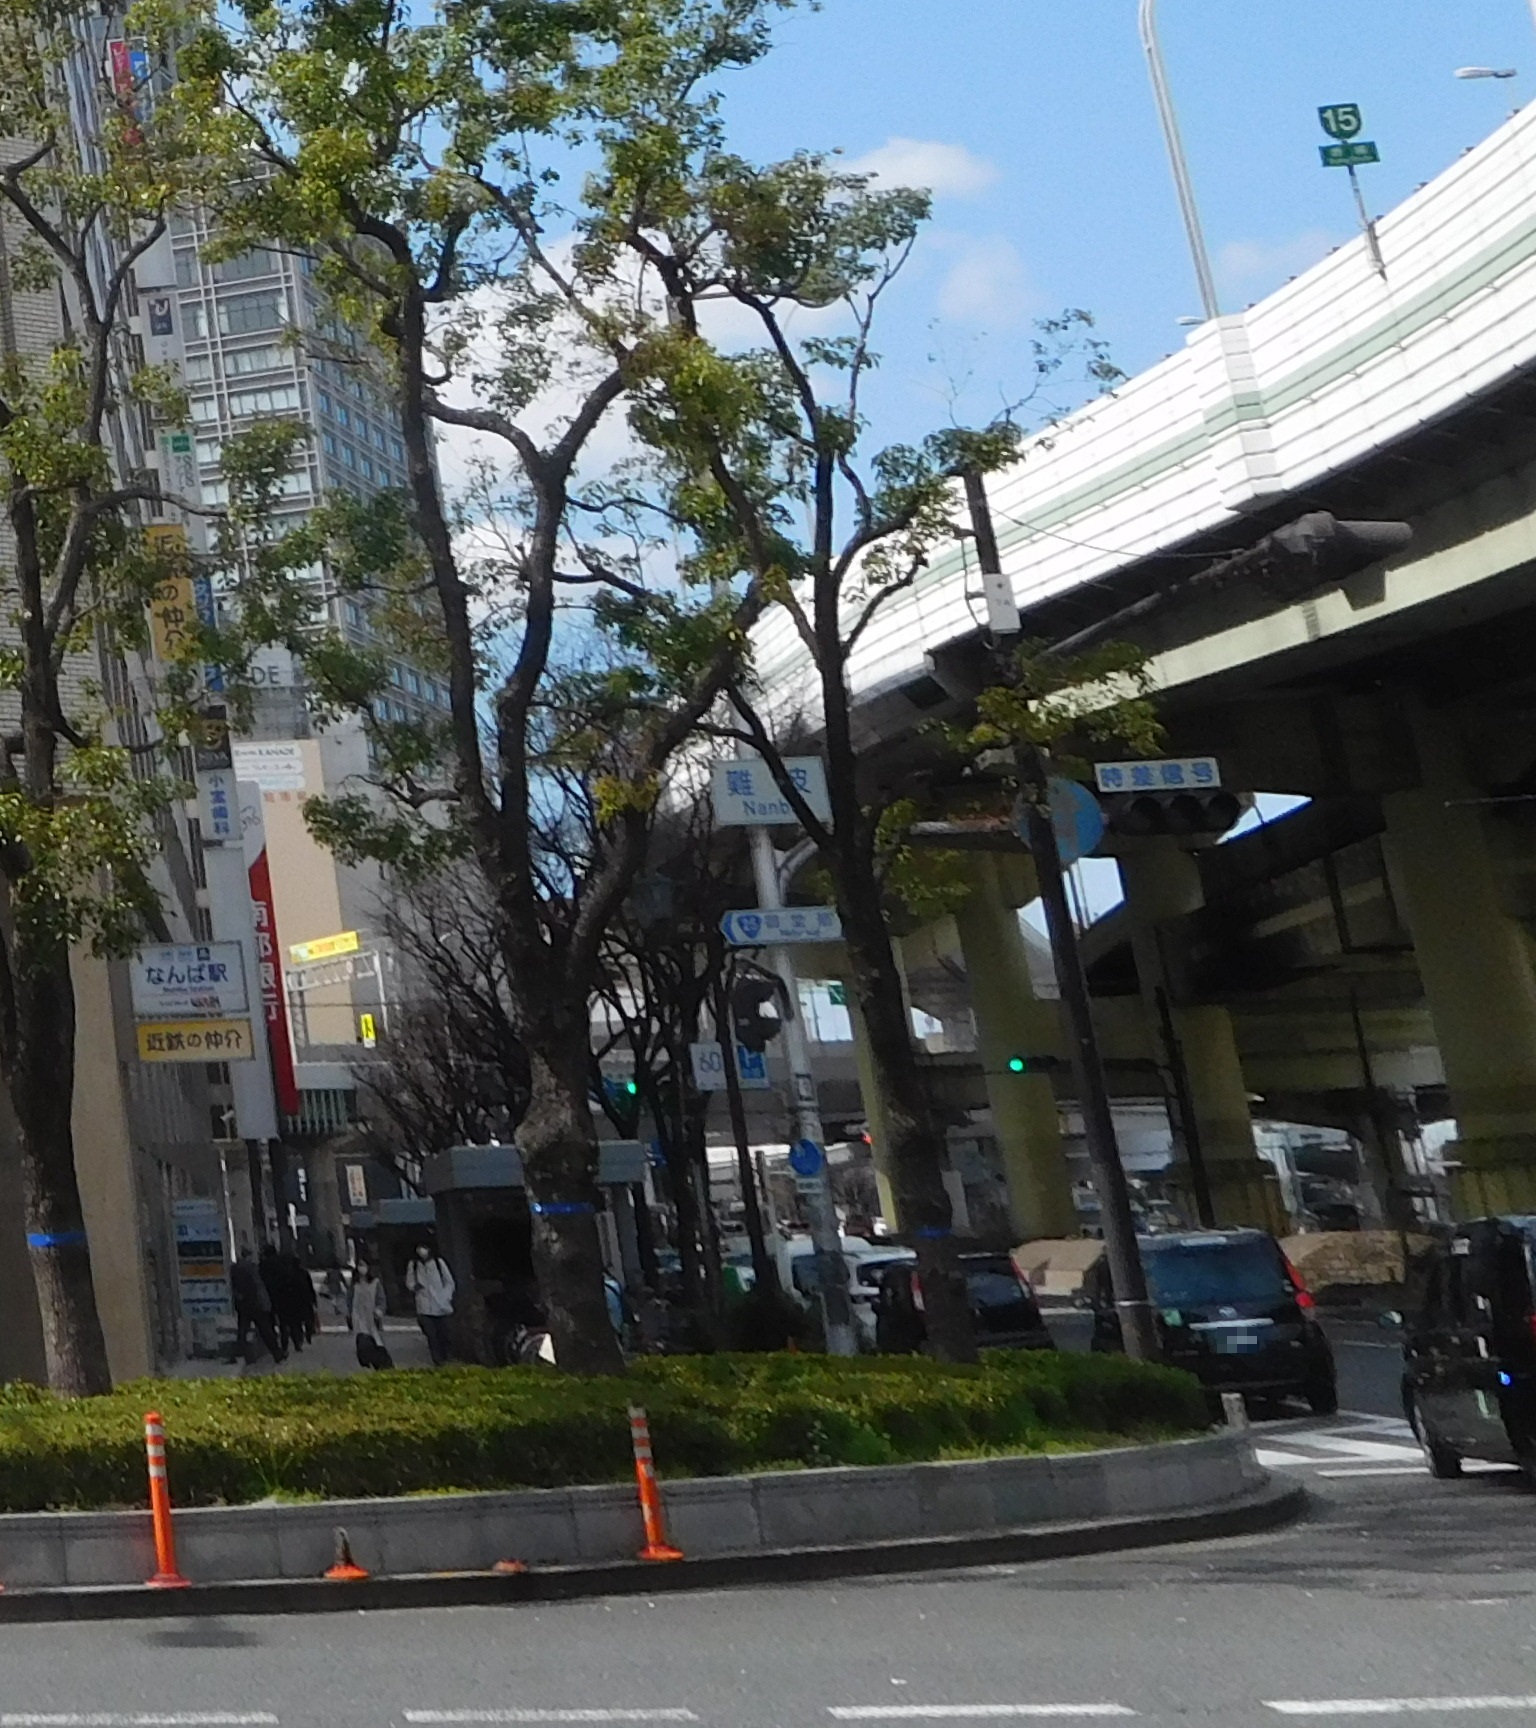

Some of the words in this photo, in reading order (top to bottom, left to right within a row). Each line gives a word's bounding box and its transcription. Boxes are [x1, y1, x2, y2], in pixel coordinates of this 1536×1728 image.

[1322, 108, 1357, 134] 15
[743, 800, 792, 815] Nanb
[145, 963, 229, 984] なんば駅
[146, 1029, 242, 1052] 近鉄の仲介
